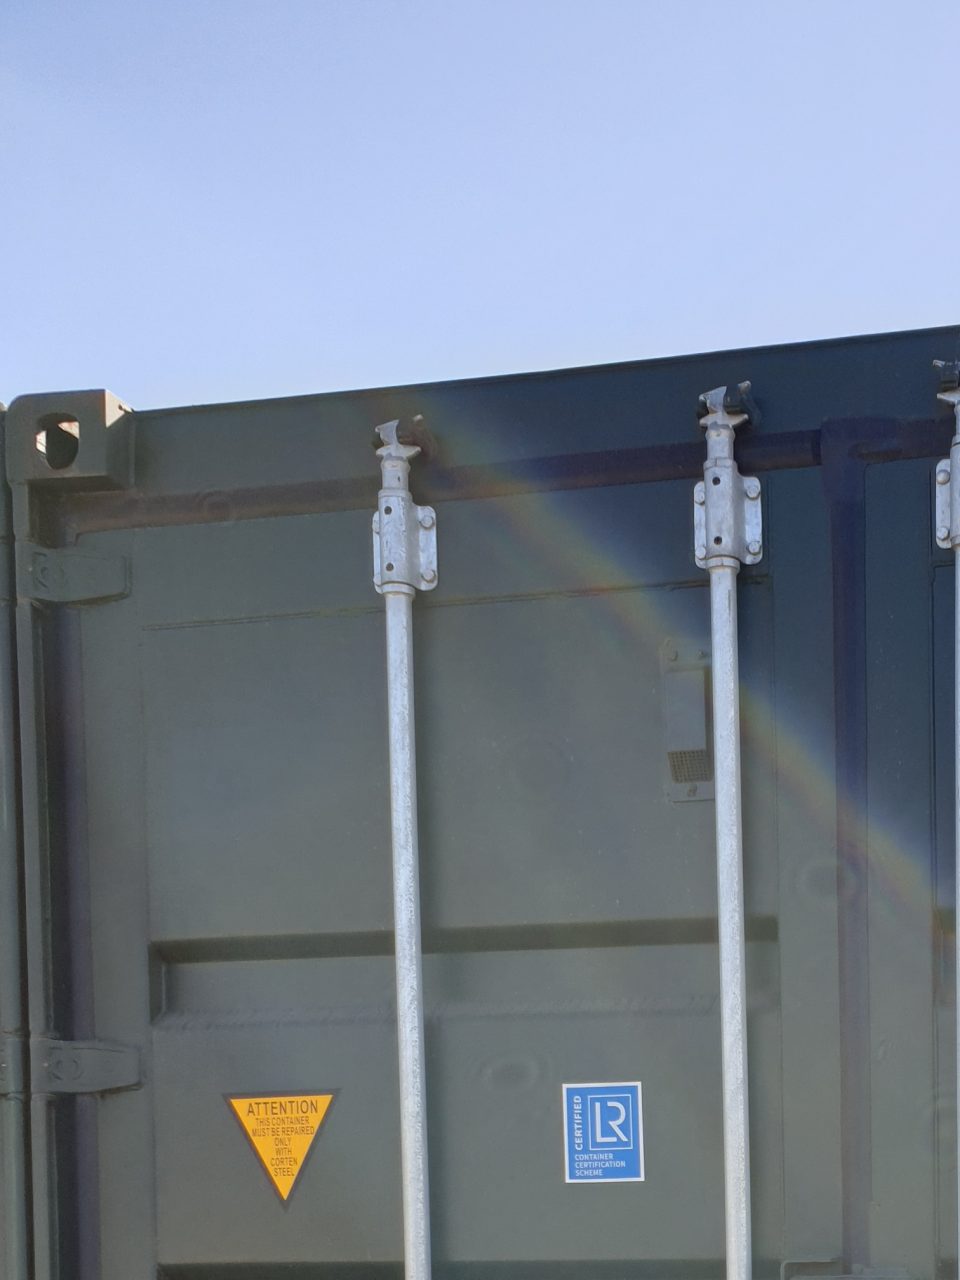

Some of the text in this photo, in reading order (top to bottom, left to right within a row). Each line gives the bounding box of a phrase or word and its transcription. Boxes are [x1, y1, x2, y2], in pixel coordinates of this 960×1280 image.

[247, 1100, 318, 1116] ATTENTION
[271, 1116, 309, 1126] CONTAINER
[573, 1095, 584, 1151] CERTIFIED
[595, 1101, 629, 1143] LR
[281, 1125, 315, 1136] REPAIRED
[574, 1152, 614, 1161] CONTAINER
[574, 1160, 626, 1169] CERTIFICATION
[575, 1168, 604, 1177] SCHEME
